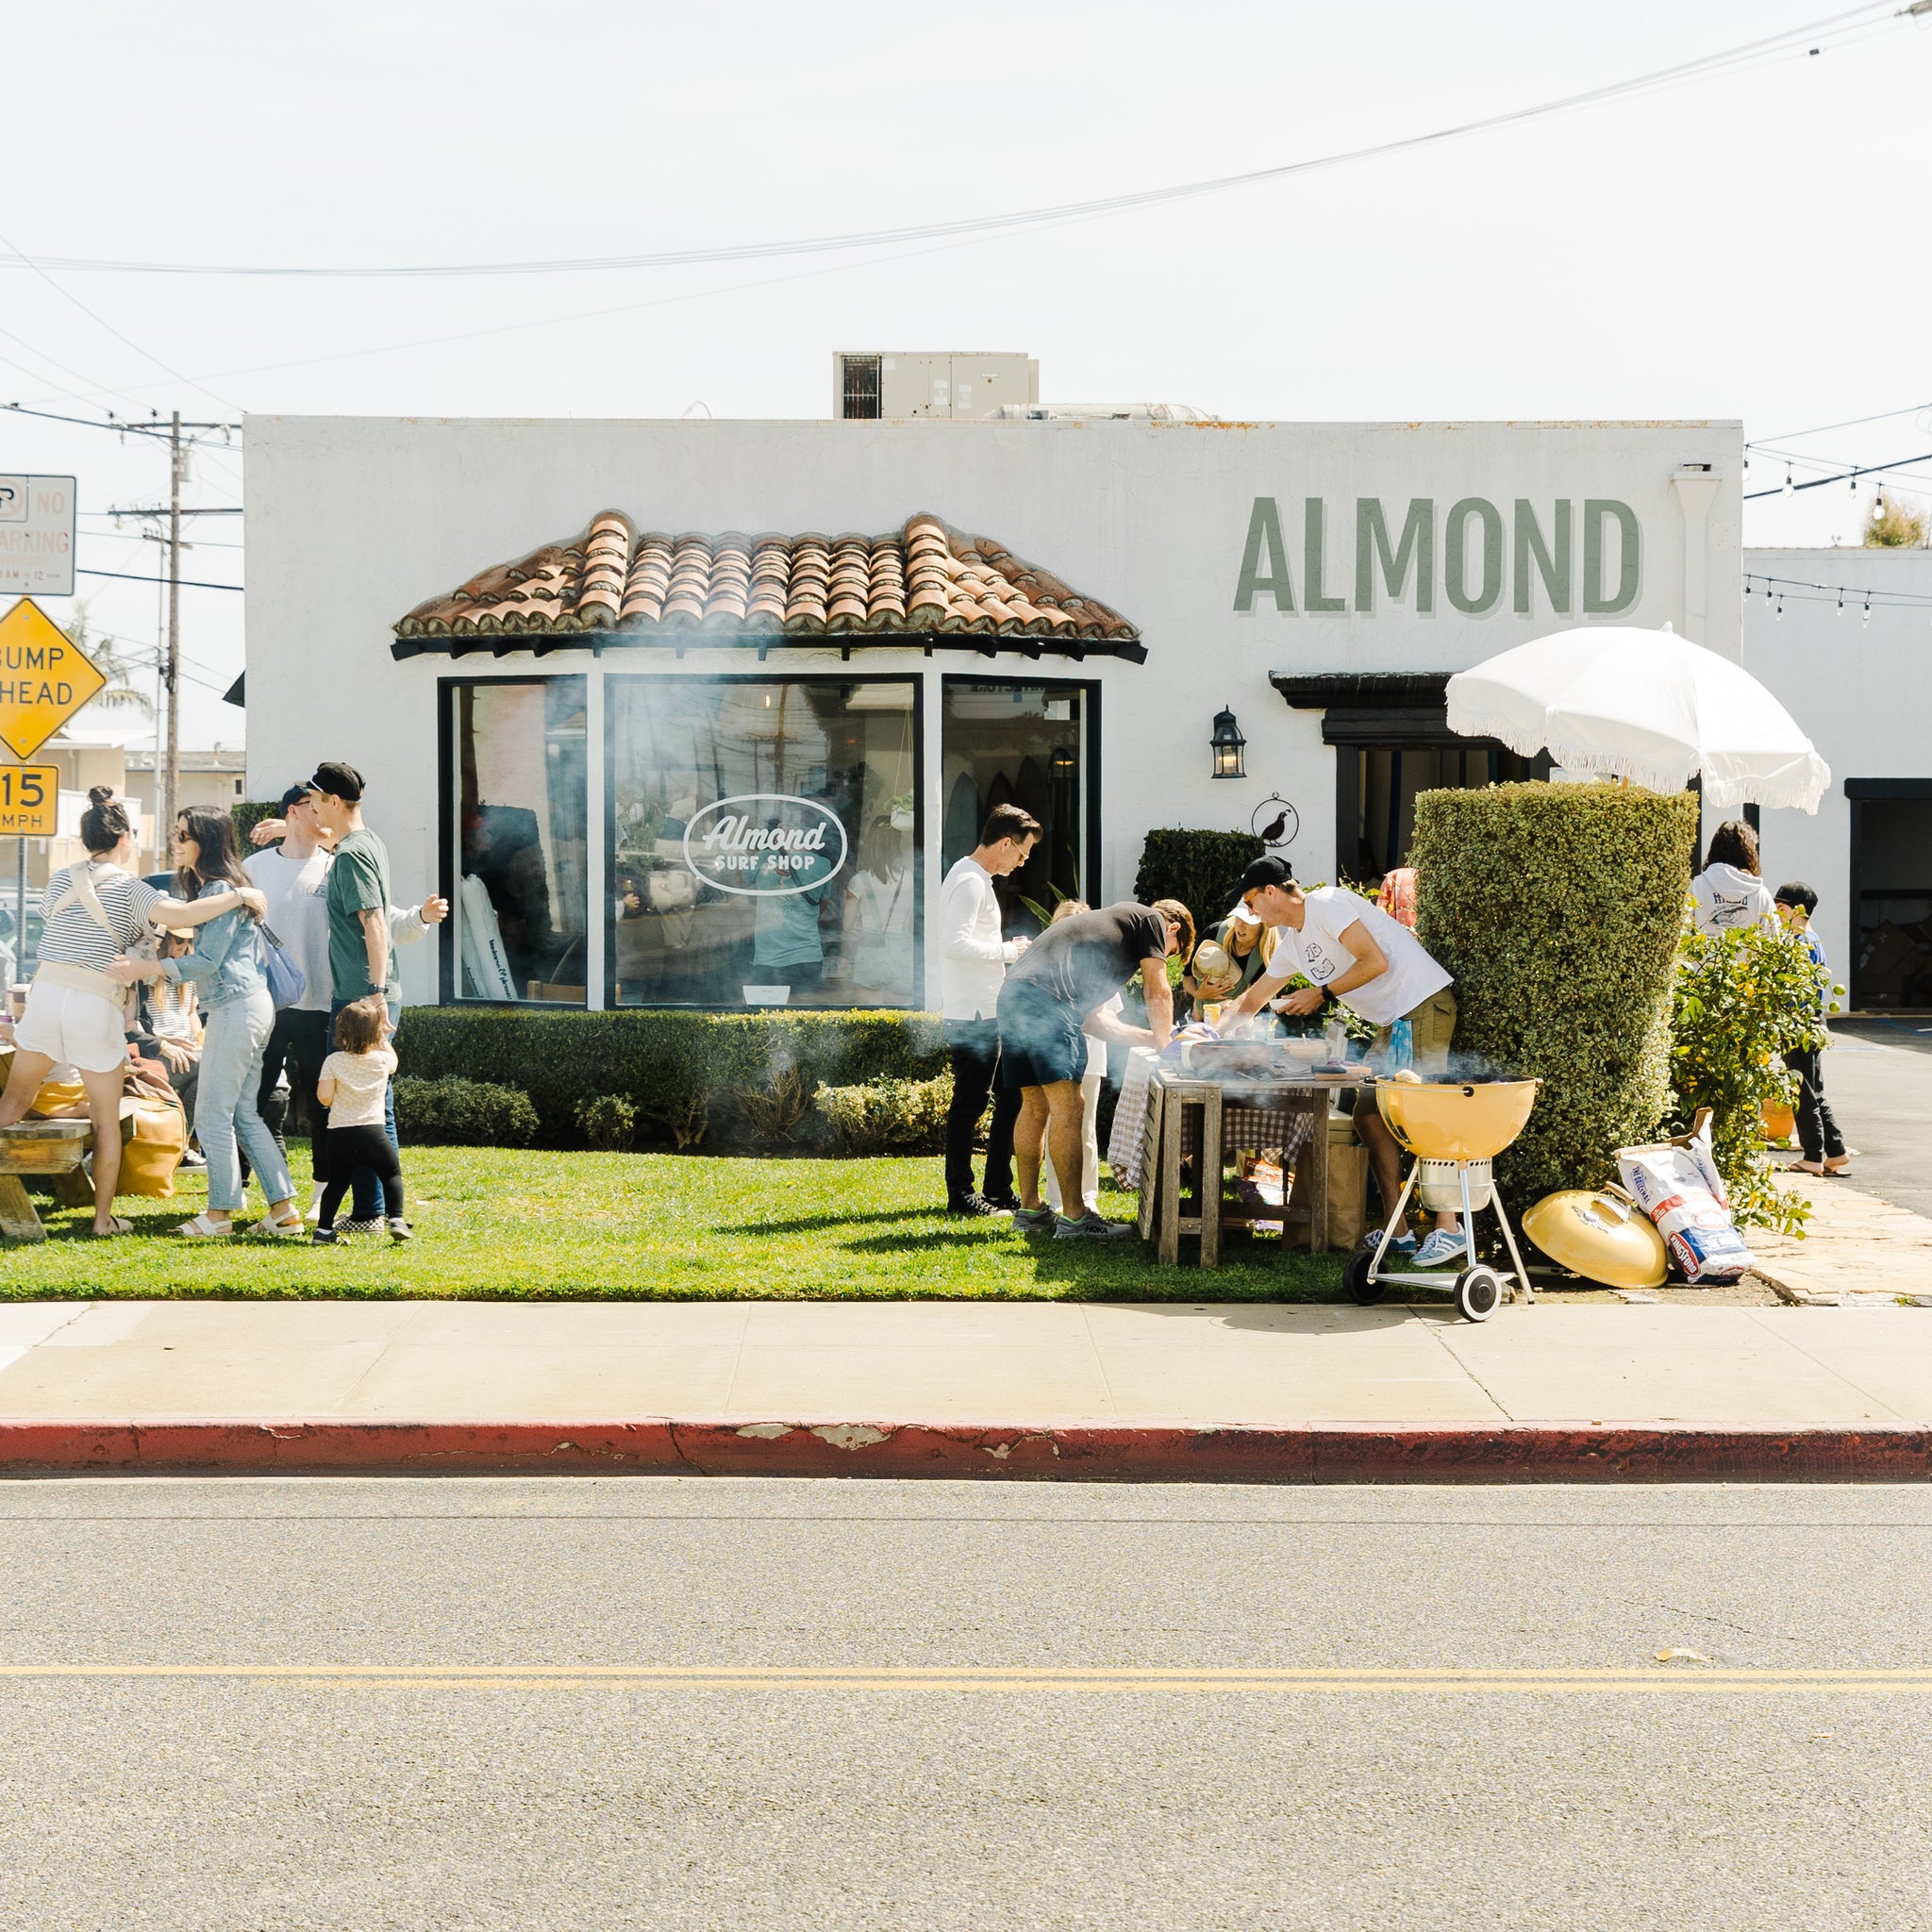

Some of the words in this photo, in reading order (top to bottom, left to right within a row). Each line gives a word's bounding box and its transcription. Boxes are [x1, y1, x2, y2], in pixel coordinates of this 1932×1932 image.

[36, 491, 65, 514] NO
[0, 530, 69, 554] ARKING
[1233, 497, 1641, 617] ALMOND
[0, 647, 64, 670] UMP
[0, 682, 73, 706] HEAD
[2, 773, 44, 808] 15
[2, 814, 43, 828] MPH
[702, 815, 827, 850] Almond
[716, 855, 759, 872] SURF
[767, 855, 815, 871] SHOP
[1670, 1235, 1697, 1274] KINGSFORD
